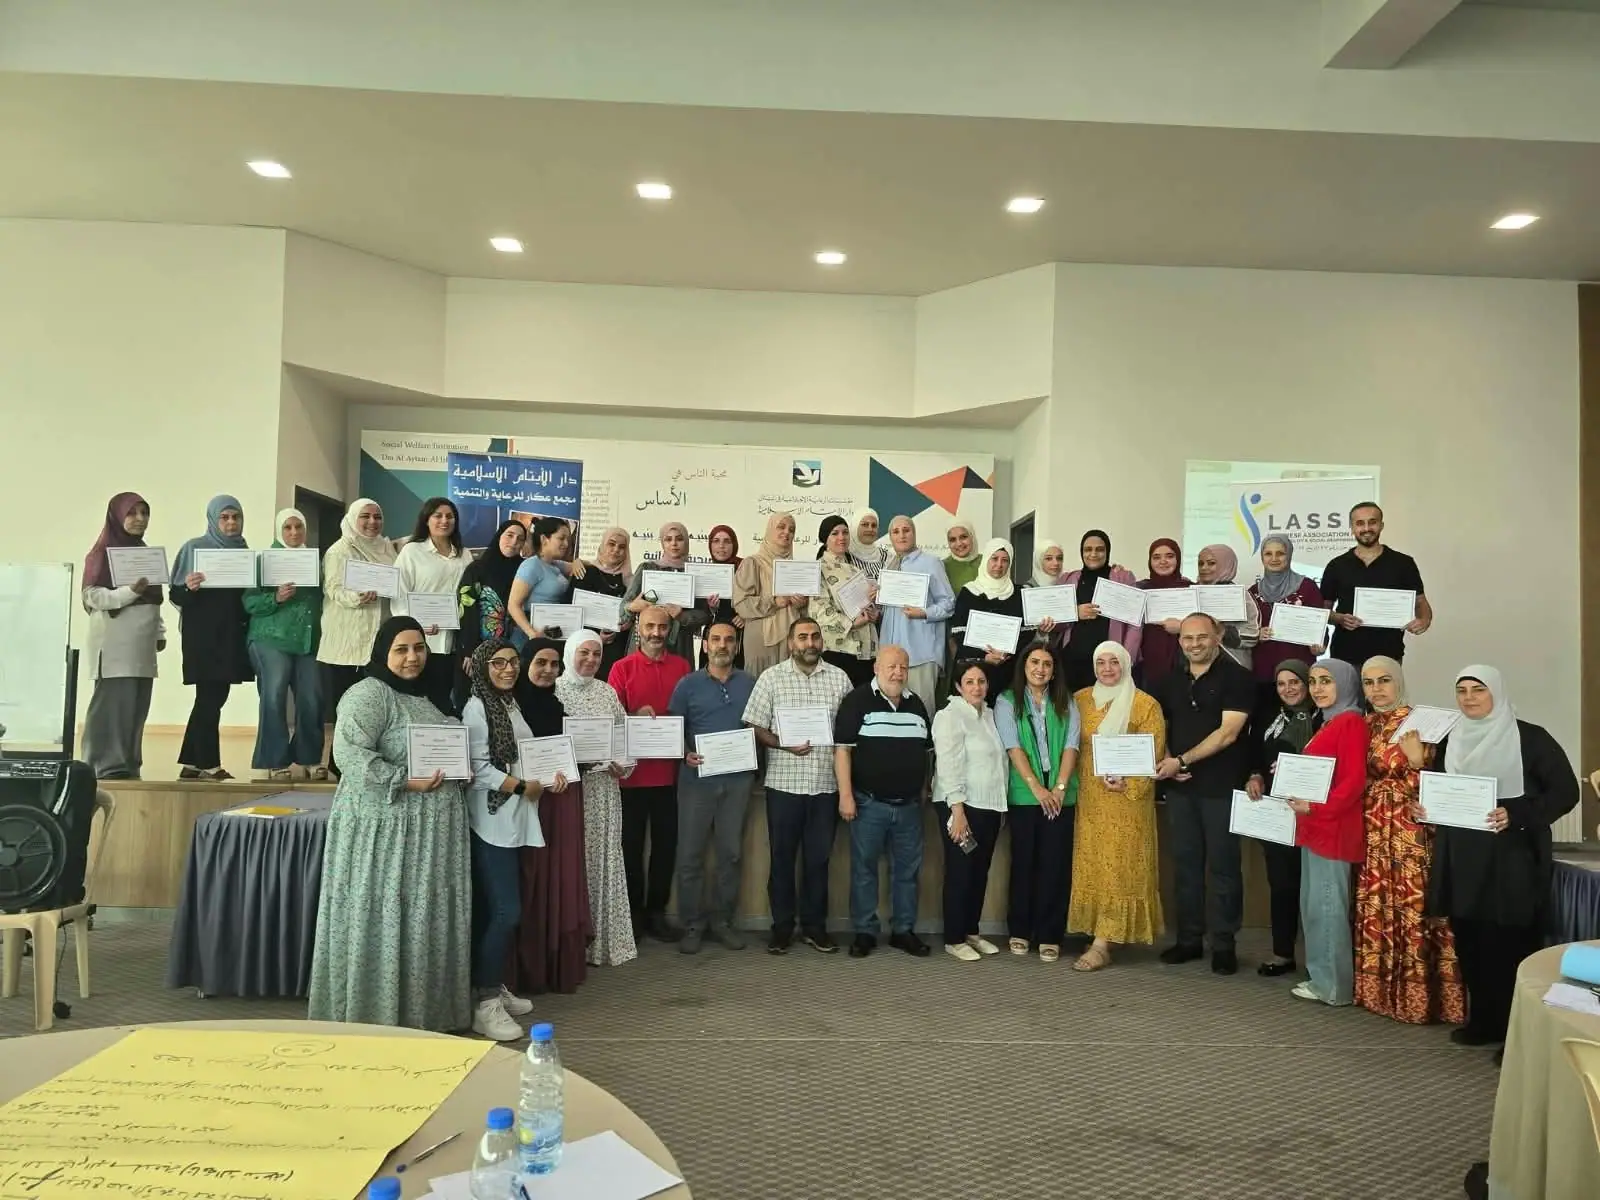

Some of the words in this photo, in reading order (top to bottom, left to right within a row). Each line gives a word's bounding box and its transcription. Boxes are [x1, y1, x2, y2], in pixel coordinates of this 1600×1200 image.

[381, 441, 403, 449] Social
[405, 440, 430, 449] Welfare
[512, 467, 552, 487] الأيتام
[557, 471, 577, 488] دار
[671, 469, 682, 482] في
[684, 468, 708, 481] الناس
[453, 486, 489, 500] والتنمية
[491, 488, 524, 502] للرعاية
[525, 491, 552, 503] عكار
[635, 485, 687, 511] الأساس
[553, 494, 576, 506] مجمع
